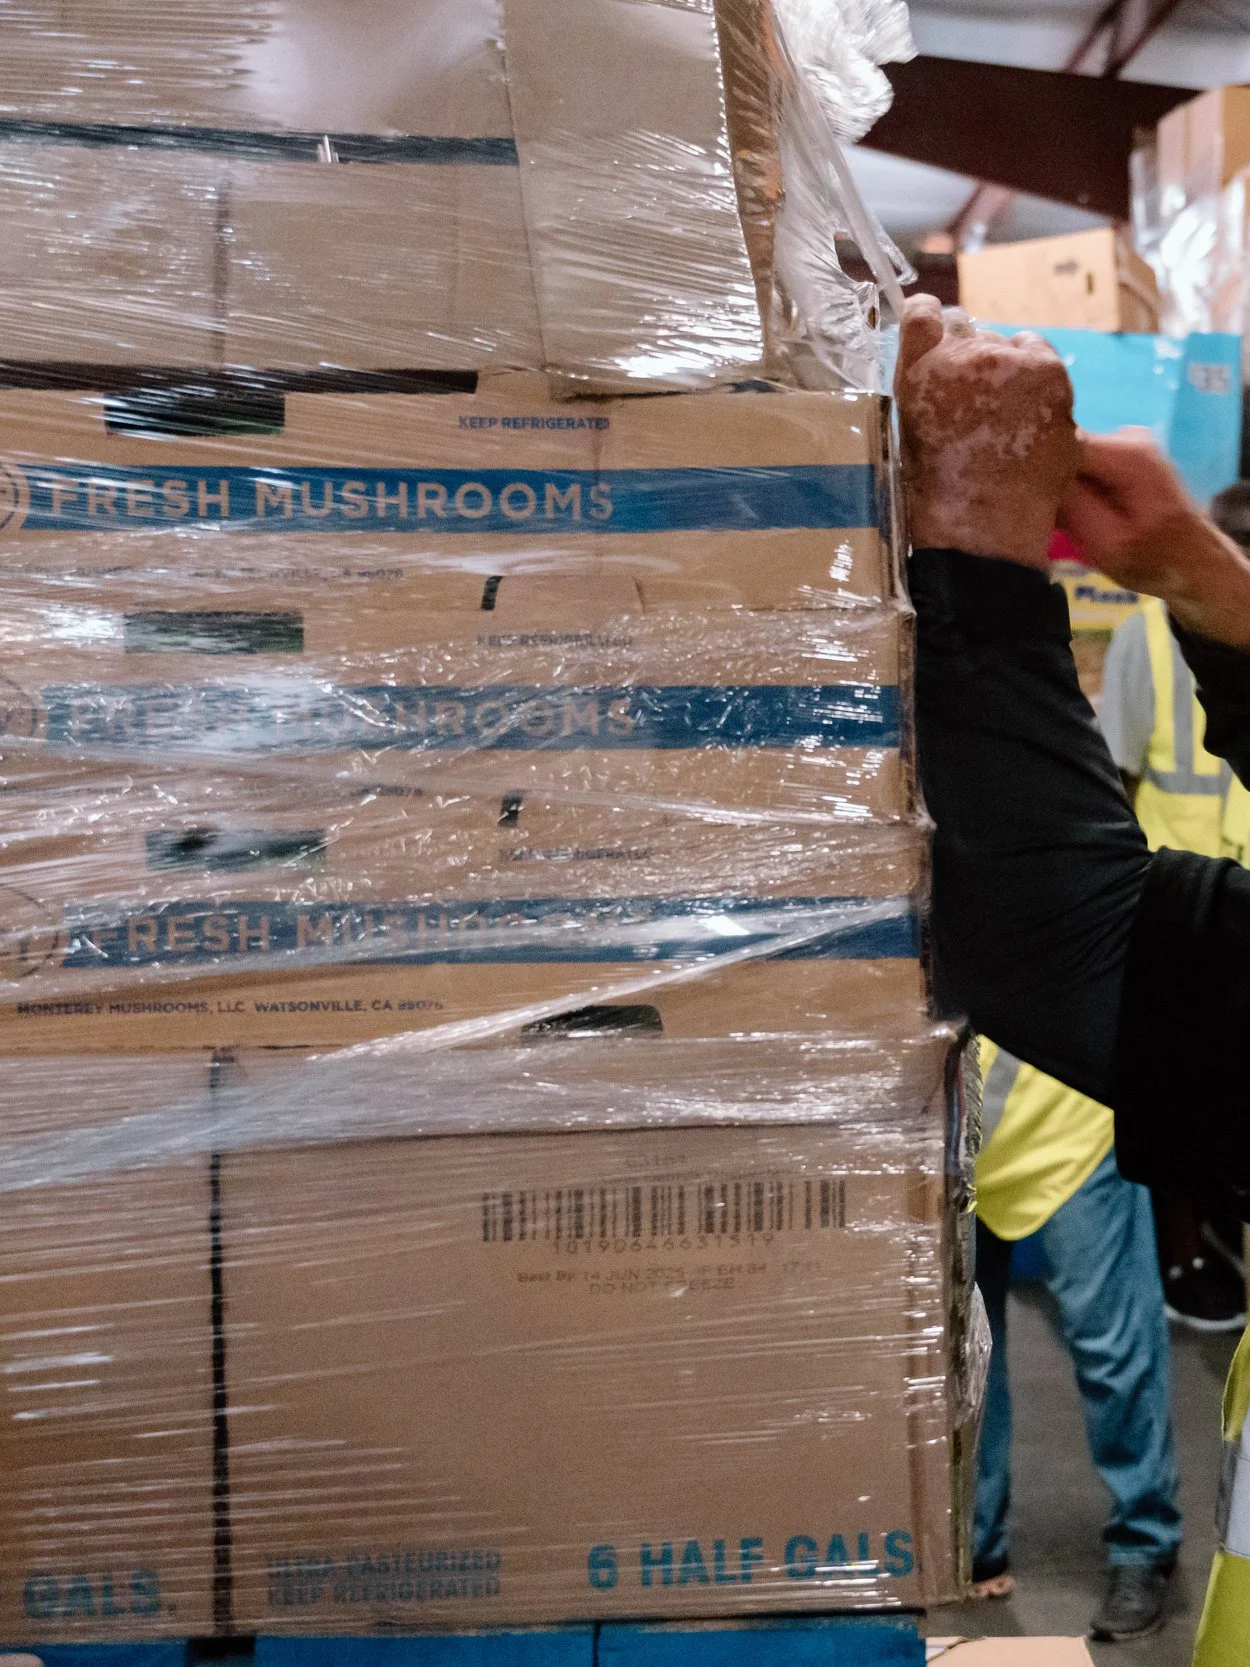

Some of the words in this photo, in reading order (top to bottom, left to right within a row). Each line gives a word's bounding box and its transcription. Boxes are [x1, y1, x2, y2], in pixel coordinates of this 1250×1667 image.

[459, 416, 496, 429] KEEP
[502, 416, 610, 430] REFRIGERATED
[52, 479, 230, 517] FRESH
[255, 479, 614, 520] MUSHROOMS
[17, 1001, 102, 1015] MONTEREY
[109, 1001, 214, 1015] MUSHROOMS,
[217, 1000, 246, 1013] LLC
[254, 999, 368, 1013] WATSONVILLE,
[371, 1000, 393, 1012] CA
[663, 1276, 737, 1292] FEEZE
[586, 1544, 619, 1590] 6
[639, 1536, 764, 1588] HALF
[783, 1529, 915, 1580] GALS
